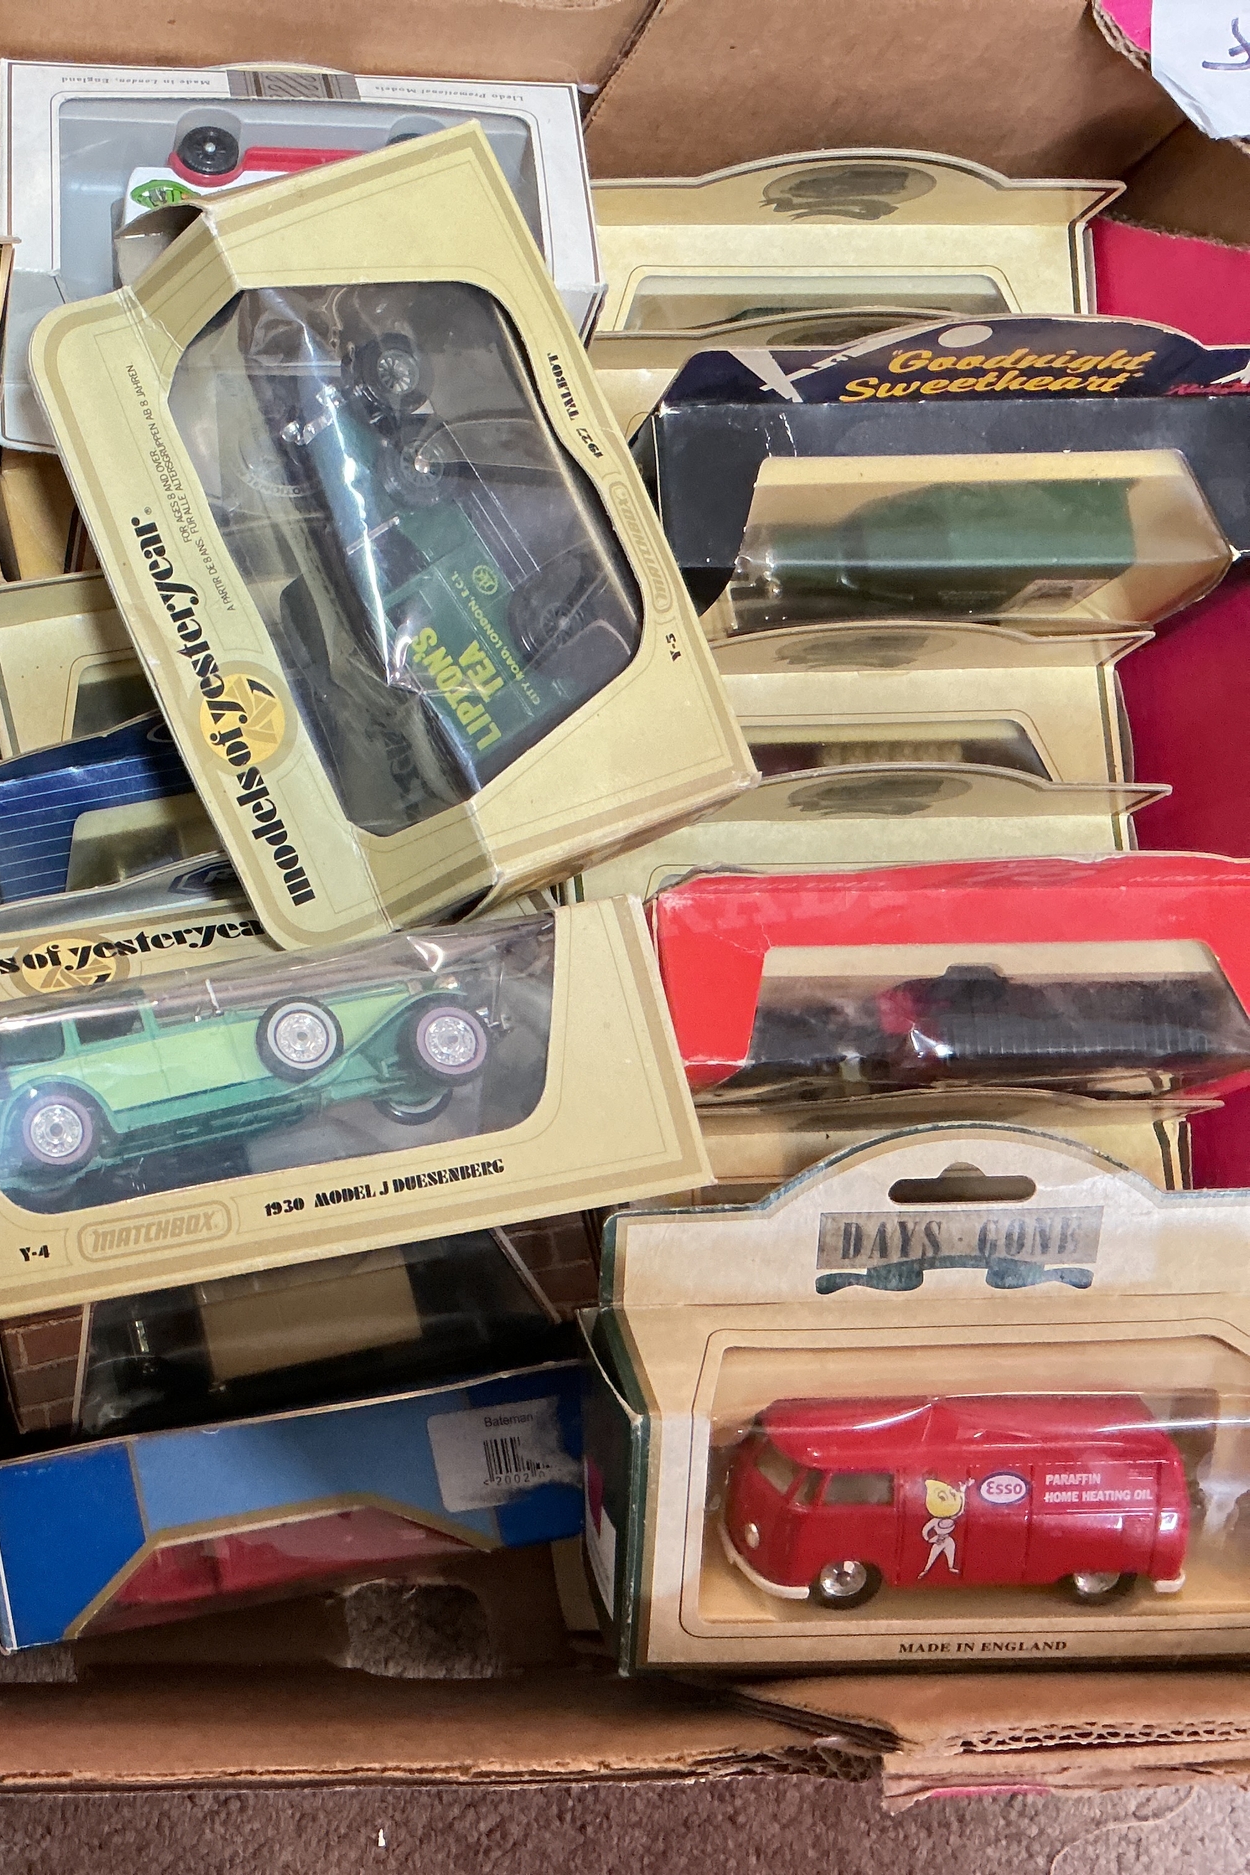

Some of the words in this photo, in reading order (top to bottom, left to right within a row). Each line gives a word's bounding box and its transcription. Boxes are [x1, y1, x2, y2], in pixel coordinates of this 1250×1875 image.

[60, 76, 109, 84] England
[114, 77, 158, 86] London,
[374, 85, 416, 93] Models
[417, 87, 485, 99] Promotional
[491, 93, 523, 102] Lledo
[547, 352, 579, 421] TALBOT
[140, 399, 147, 407] 8
[143, 408, 153, 420] AB
[576, 427, 604, 460] 1927
[148, 422, 183, 491] ALTERSGRUPPEN
[159, 473, 173, 492] AND
[168, 493, 176, 501] 8
[177, 494, 193, 517] ALLE
[170, 501, 187, 524] AGES
[179, 525, 192, 543] FOR
[184, 515, 200, 535] FÜR
[195, 537, 210, 557] ANS.
[621, 496, 664, 602] MATCHBOX
[208, 564, 218, 576] DE
[212, 577, 231, 604] PARTIR
[130, 516, 249, 726] yesteryear
[468, 597, 503, 649] LONDON,
[665, 632, 682, 662] Y-5
[459, 640, 504, 703] TEA
[500, 645, 525, 681] ROAD,
[411, 627, 502, 751] LIPTON'S
[521, 682, 540, 705] CITY
[209, 726, 252, 767] of
[235, 766, 316, 906] models
[22, 944, 62, 970] of
[64, 920, 266, 972] yesteryea
[264, 1197, 305, 1217] 1930
[314, 1183, 377, 1208] MODEL
[379, 1180, 390, 1196] J
[393, 1158, 505, 1194] DUESENBERG
[90, 1207, 222, 1252] MATCHBOX
[841, 1220, 942, 1260] DAYS
[977, 1216, 1082, 1258] GONE
[19, 1244, 51, 1263] Y-4
[483, 1414, 534, 1428] Bateman
[1045, 1473, 1101, 1486] PARAFFIN
[1044, 1491, 1079, 1503] HOME
[1082, 1489, 1130, 1502] HEATING
[1134, 1489, 1153, 1500] OIL
[899, 1643, 950, 1653] MADE
[956, 1642, 975, 1652] IN
[981, 1641, 1067, 1652] ENGLAND
